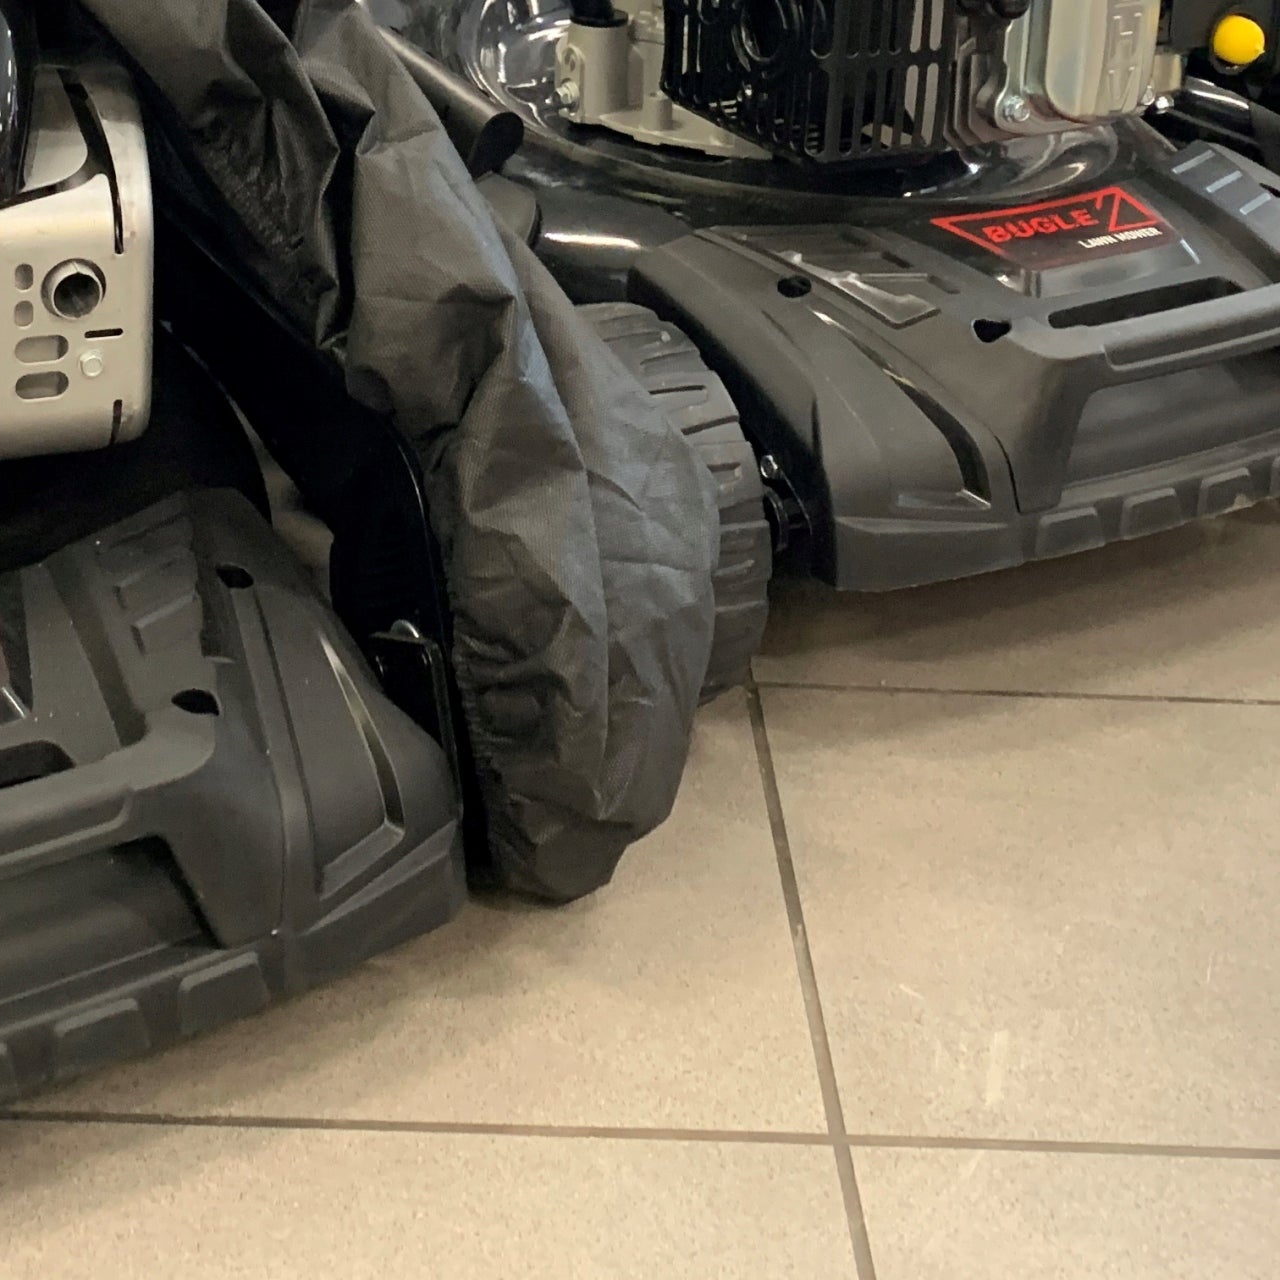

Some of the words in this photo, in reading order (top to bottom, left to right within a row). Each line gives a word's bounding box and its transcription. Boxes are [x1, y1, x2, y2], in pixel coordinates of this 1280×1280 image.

[982, 208, 1098, 243] BUGLE
[1077, 235, 1118, 249] LAWN
[1118, 227, 1162, 241] MOWER
